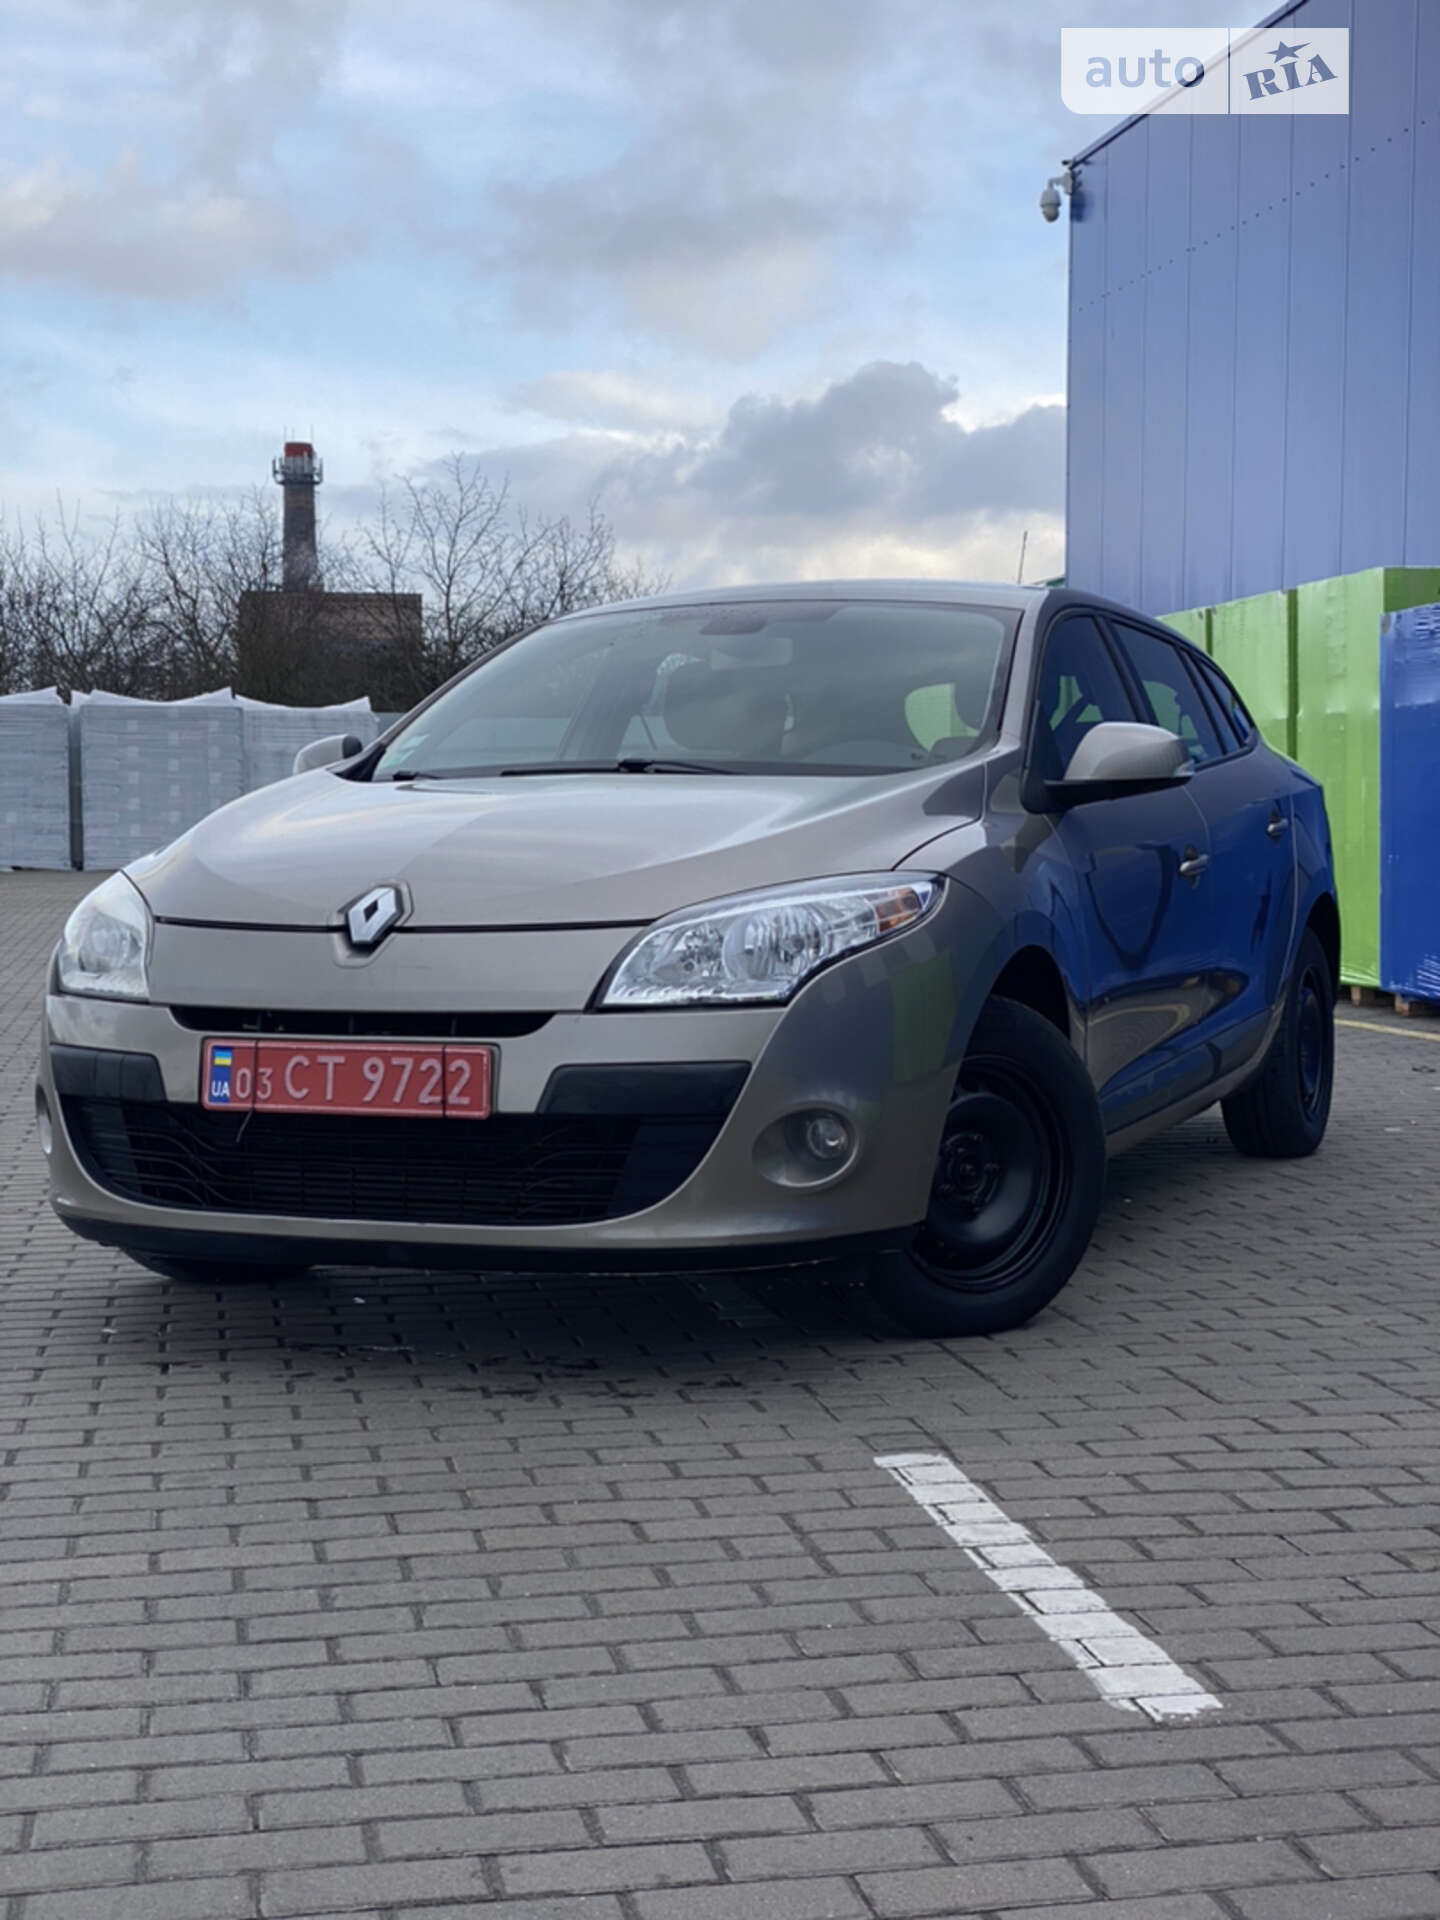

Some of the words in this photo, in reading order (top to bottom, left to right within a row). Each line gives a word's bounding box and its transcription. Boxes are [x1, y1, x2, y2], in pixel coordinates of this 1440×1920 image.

[211, 1081, 230, 1097] UA
[236, 1067, 273, 1100] 03
[284, 1055, 345, 1100] CT
[362, 1056, 471, 1105] 9722
